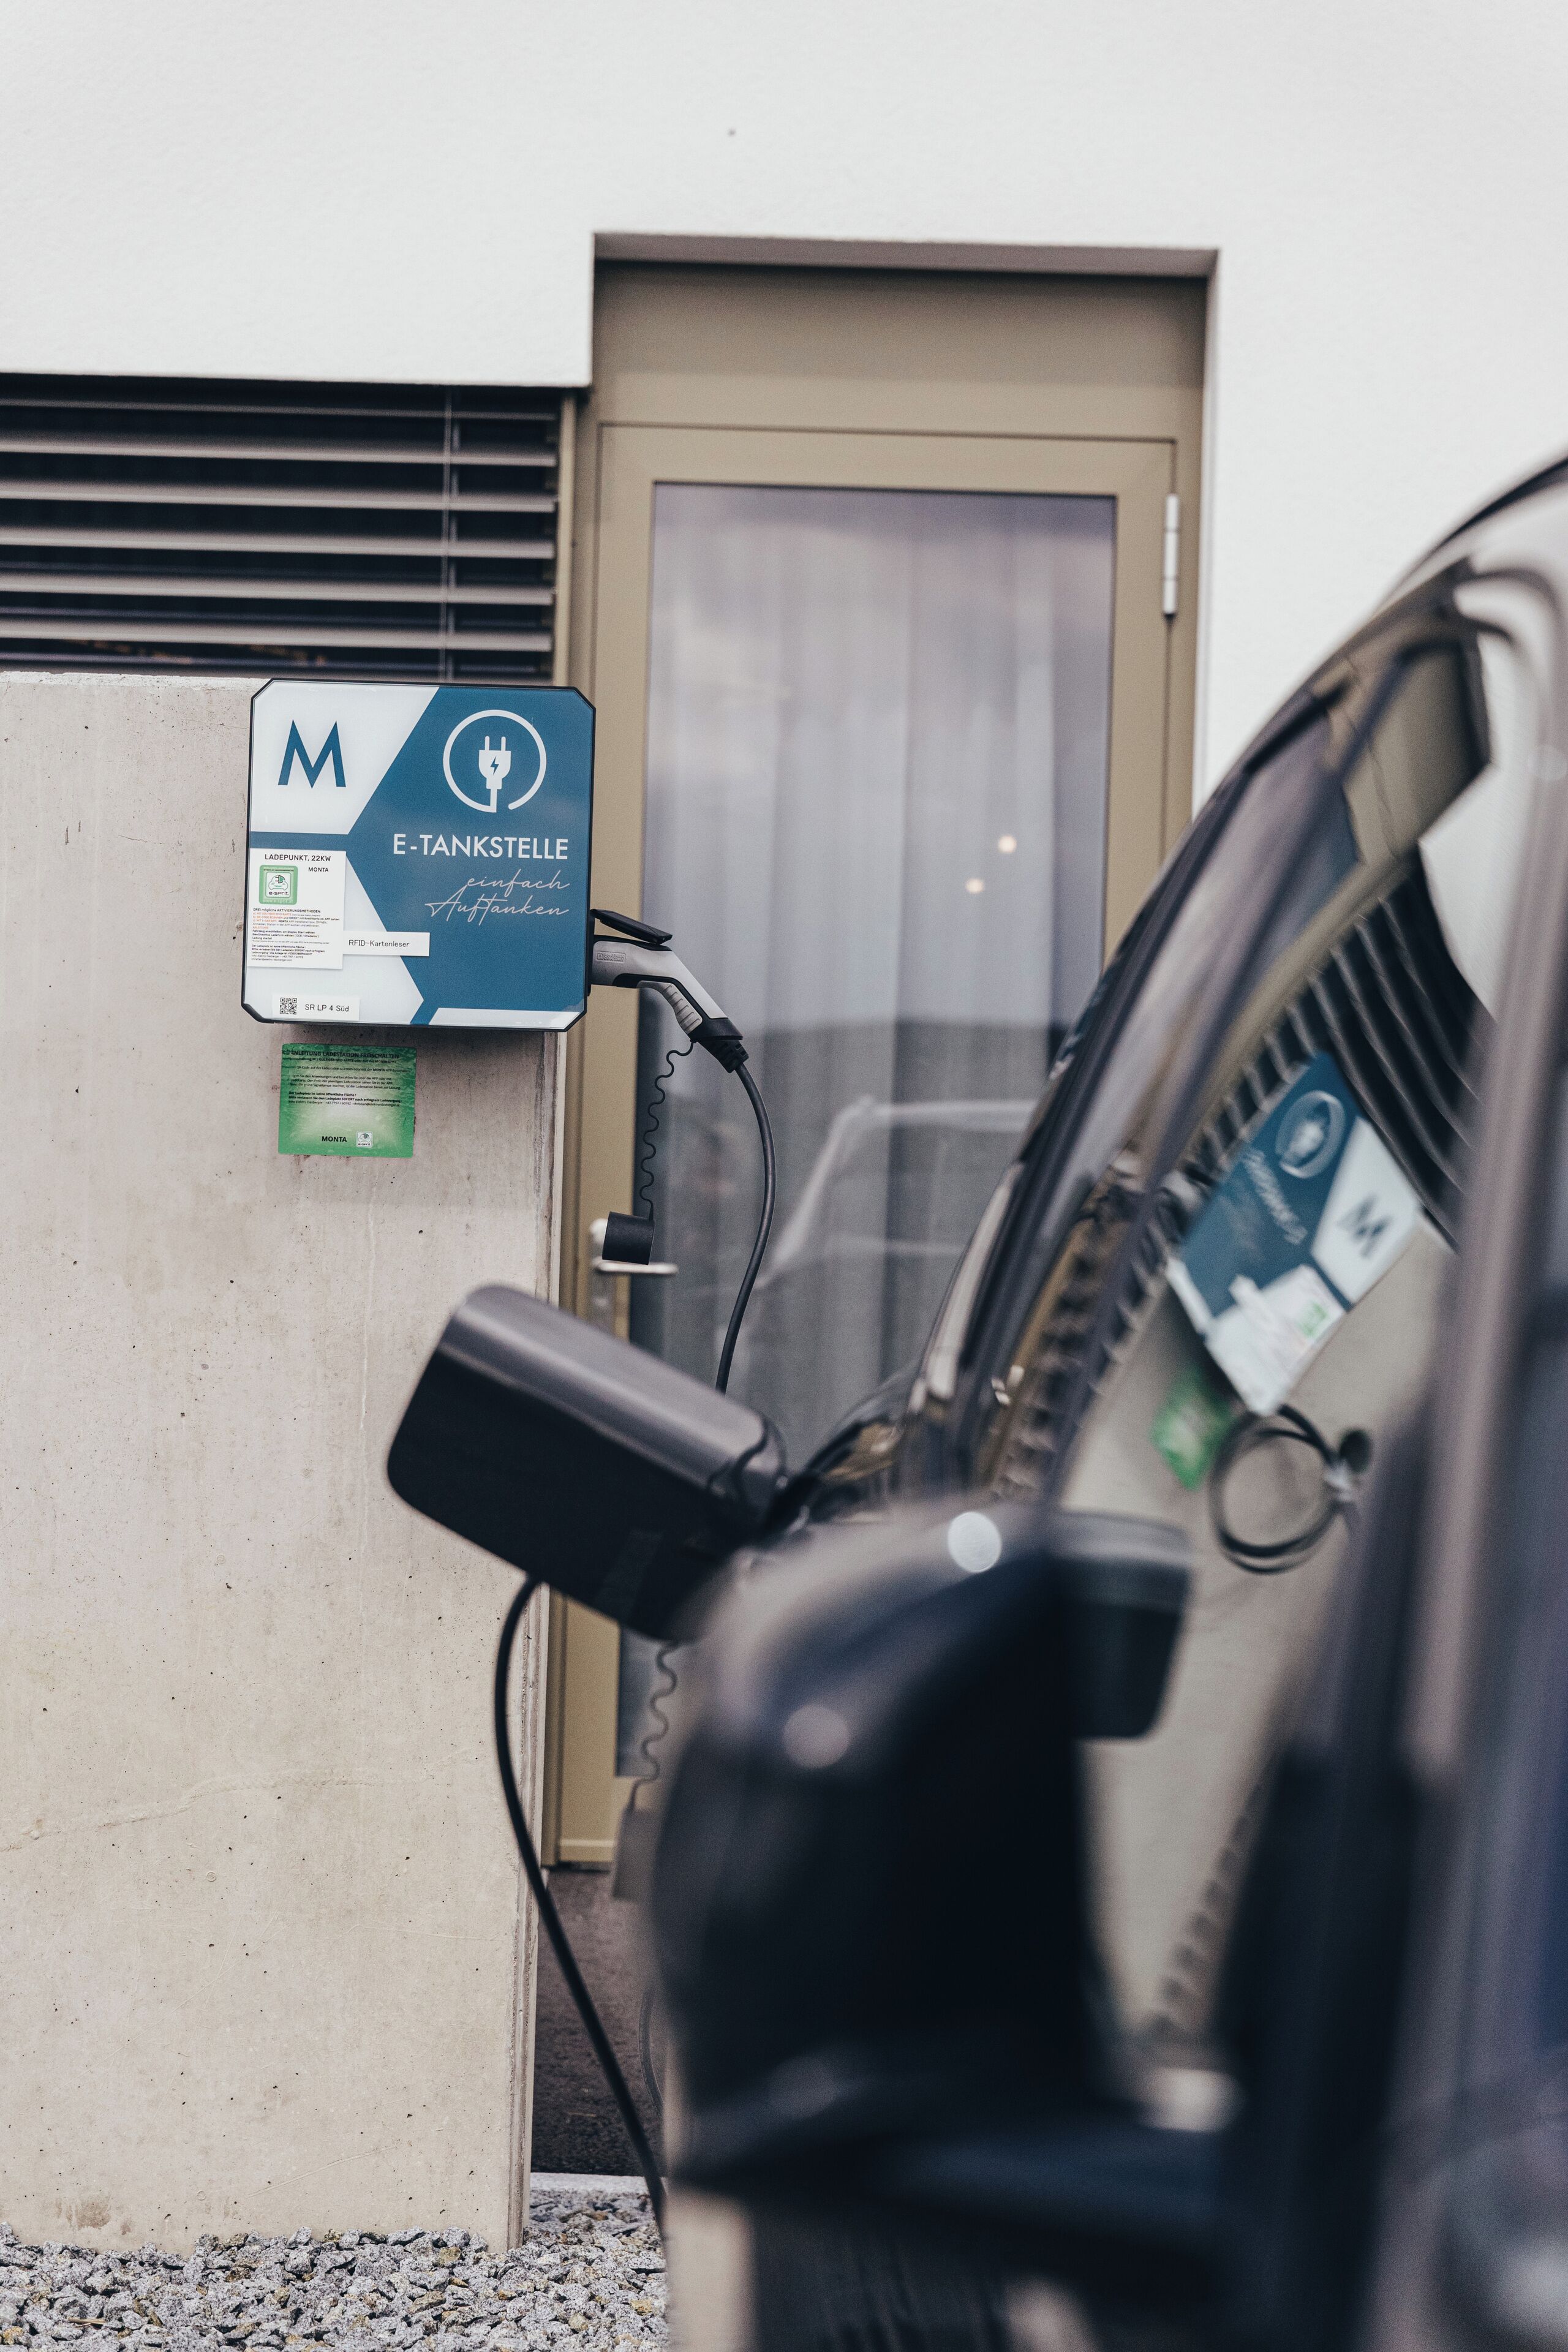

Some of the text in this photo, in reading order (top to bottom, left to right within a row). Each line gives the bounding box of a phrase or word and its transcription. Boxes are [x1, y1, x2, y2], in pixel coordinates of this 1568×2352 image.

[277, 719, 346, 789] M
[393, 834, 568, 859] E-TANKSTELLE
[467, 869, 570, 897] einfach
